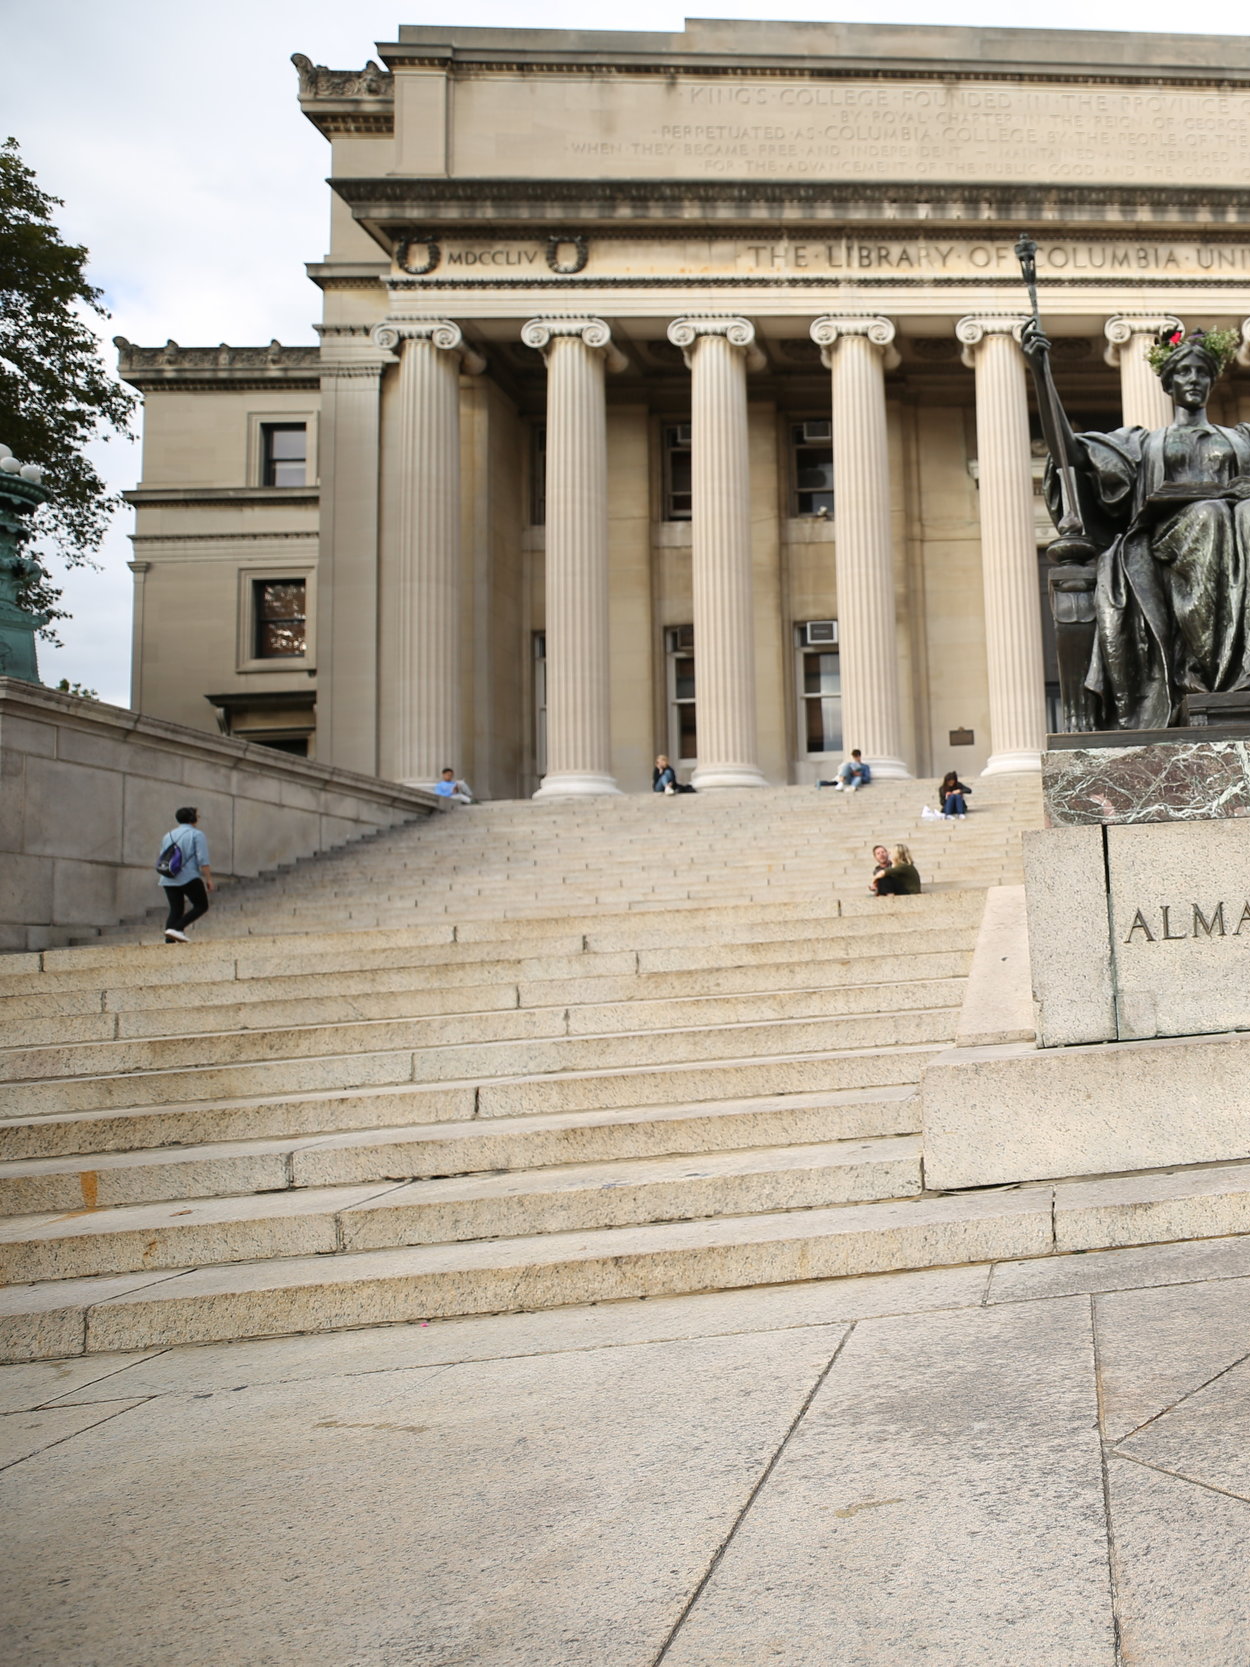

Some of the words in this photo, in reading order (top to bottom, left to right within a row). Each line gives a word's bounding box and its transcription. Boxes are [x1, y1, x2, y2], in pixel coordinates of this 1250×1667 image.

[690, 87, 767, 105] KING'S
[780, 88, 888, 106] COLLEGE
[903, 90, 1012, 109] FOUNDED
[1026, 94, 1049, 109] IN
[1061, 95, 1107, 112] THE
[1121, 96, 1229, 114] PROVINCE
[661, 125, 785, 140] PERPETUATED
[794, 127, 814, 140] AS
[824, 125, 933, 142] COLUMBIA
[942, 127, 1038, 144] COLLEGE
[1048, 130, 1066, 144] BY
[1075, 131, 1110, 145] THE
[1118, 132, 1176, 146] PEOPLE
[1184, 133, 1207, 147] OF
[1215, 134, 1248, 148] THE
[447, 250, 538, 266] MDCCLIV
[748, 246, 806, 268] THE
[828, 246, 953, 268] LIBRARY
[970, 246, 1009, 268] OF
